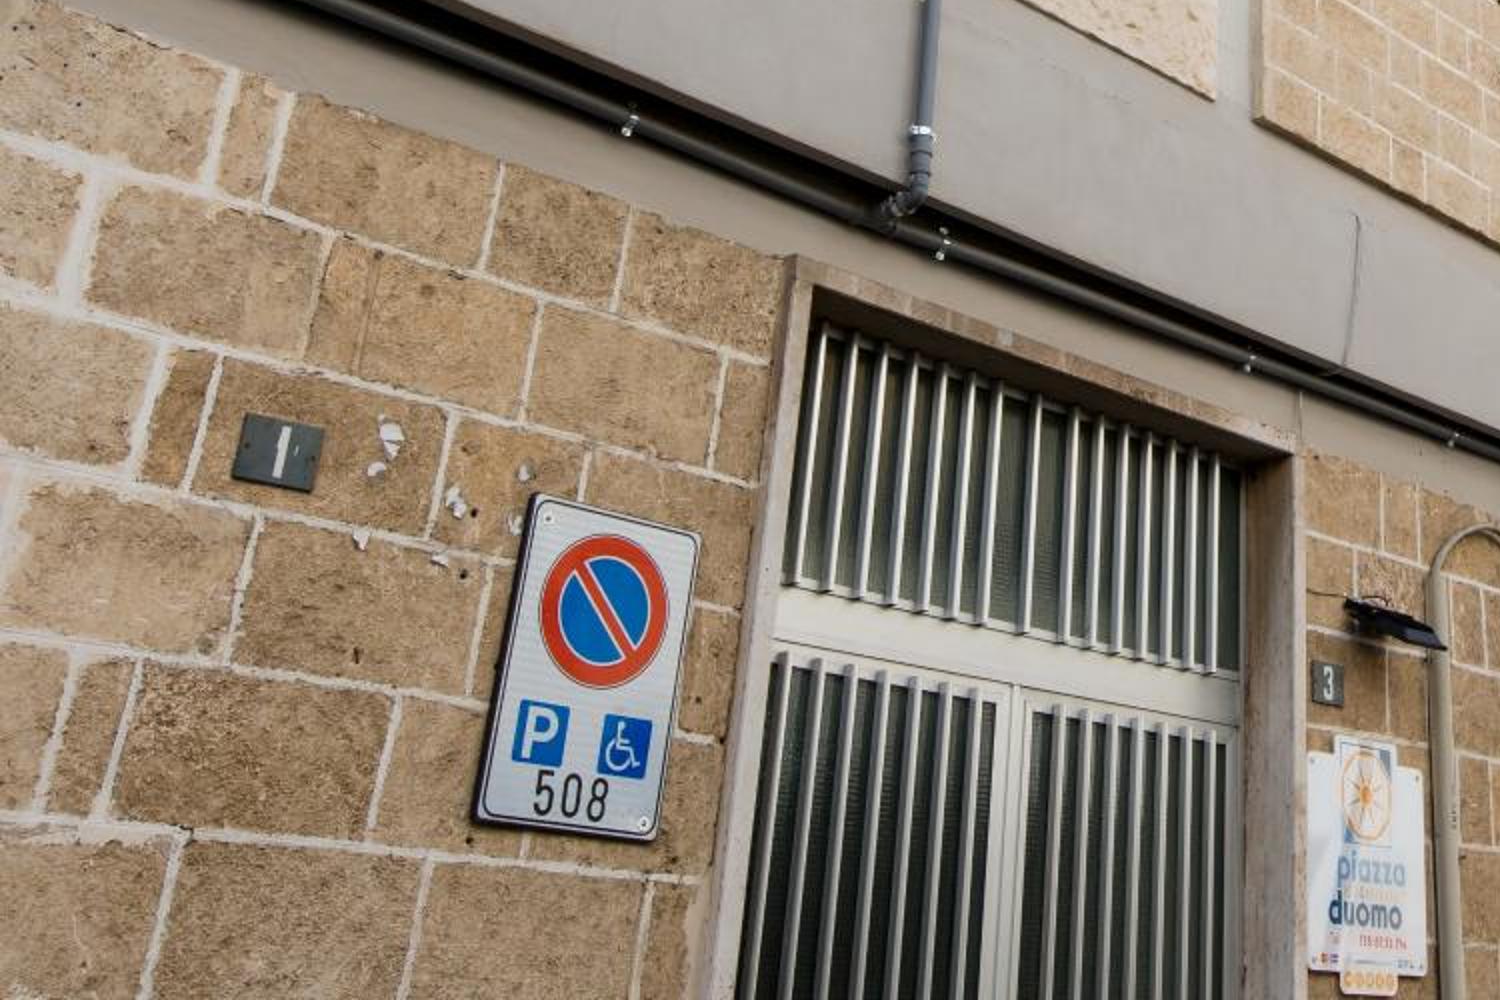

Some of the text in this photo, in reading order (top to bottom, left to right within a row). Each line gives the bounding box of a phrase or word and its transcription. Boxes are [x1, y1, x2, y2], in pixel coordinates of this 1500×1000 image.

[272, 425, 292, 479] 1
[1323, 664, 1335, 701] 3
[521, 705, 560, 759] P
[533, 769, 609, 823] 508
[1337, 851, 1407, 890] piazza
[1328, 890, 1403, 931] duomo
